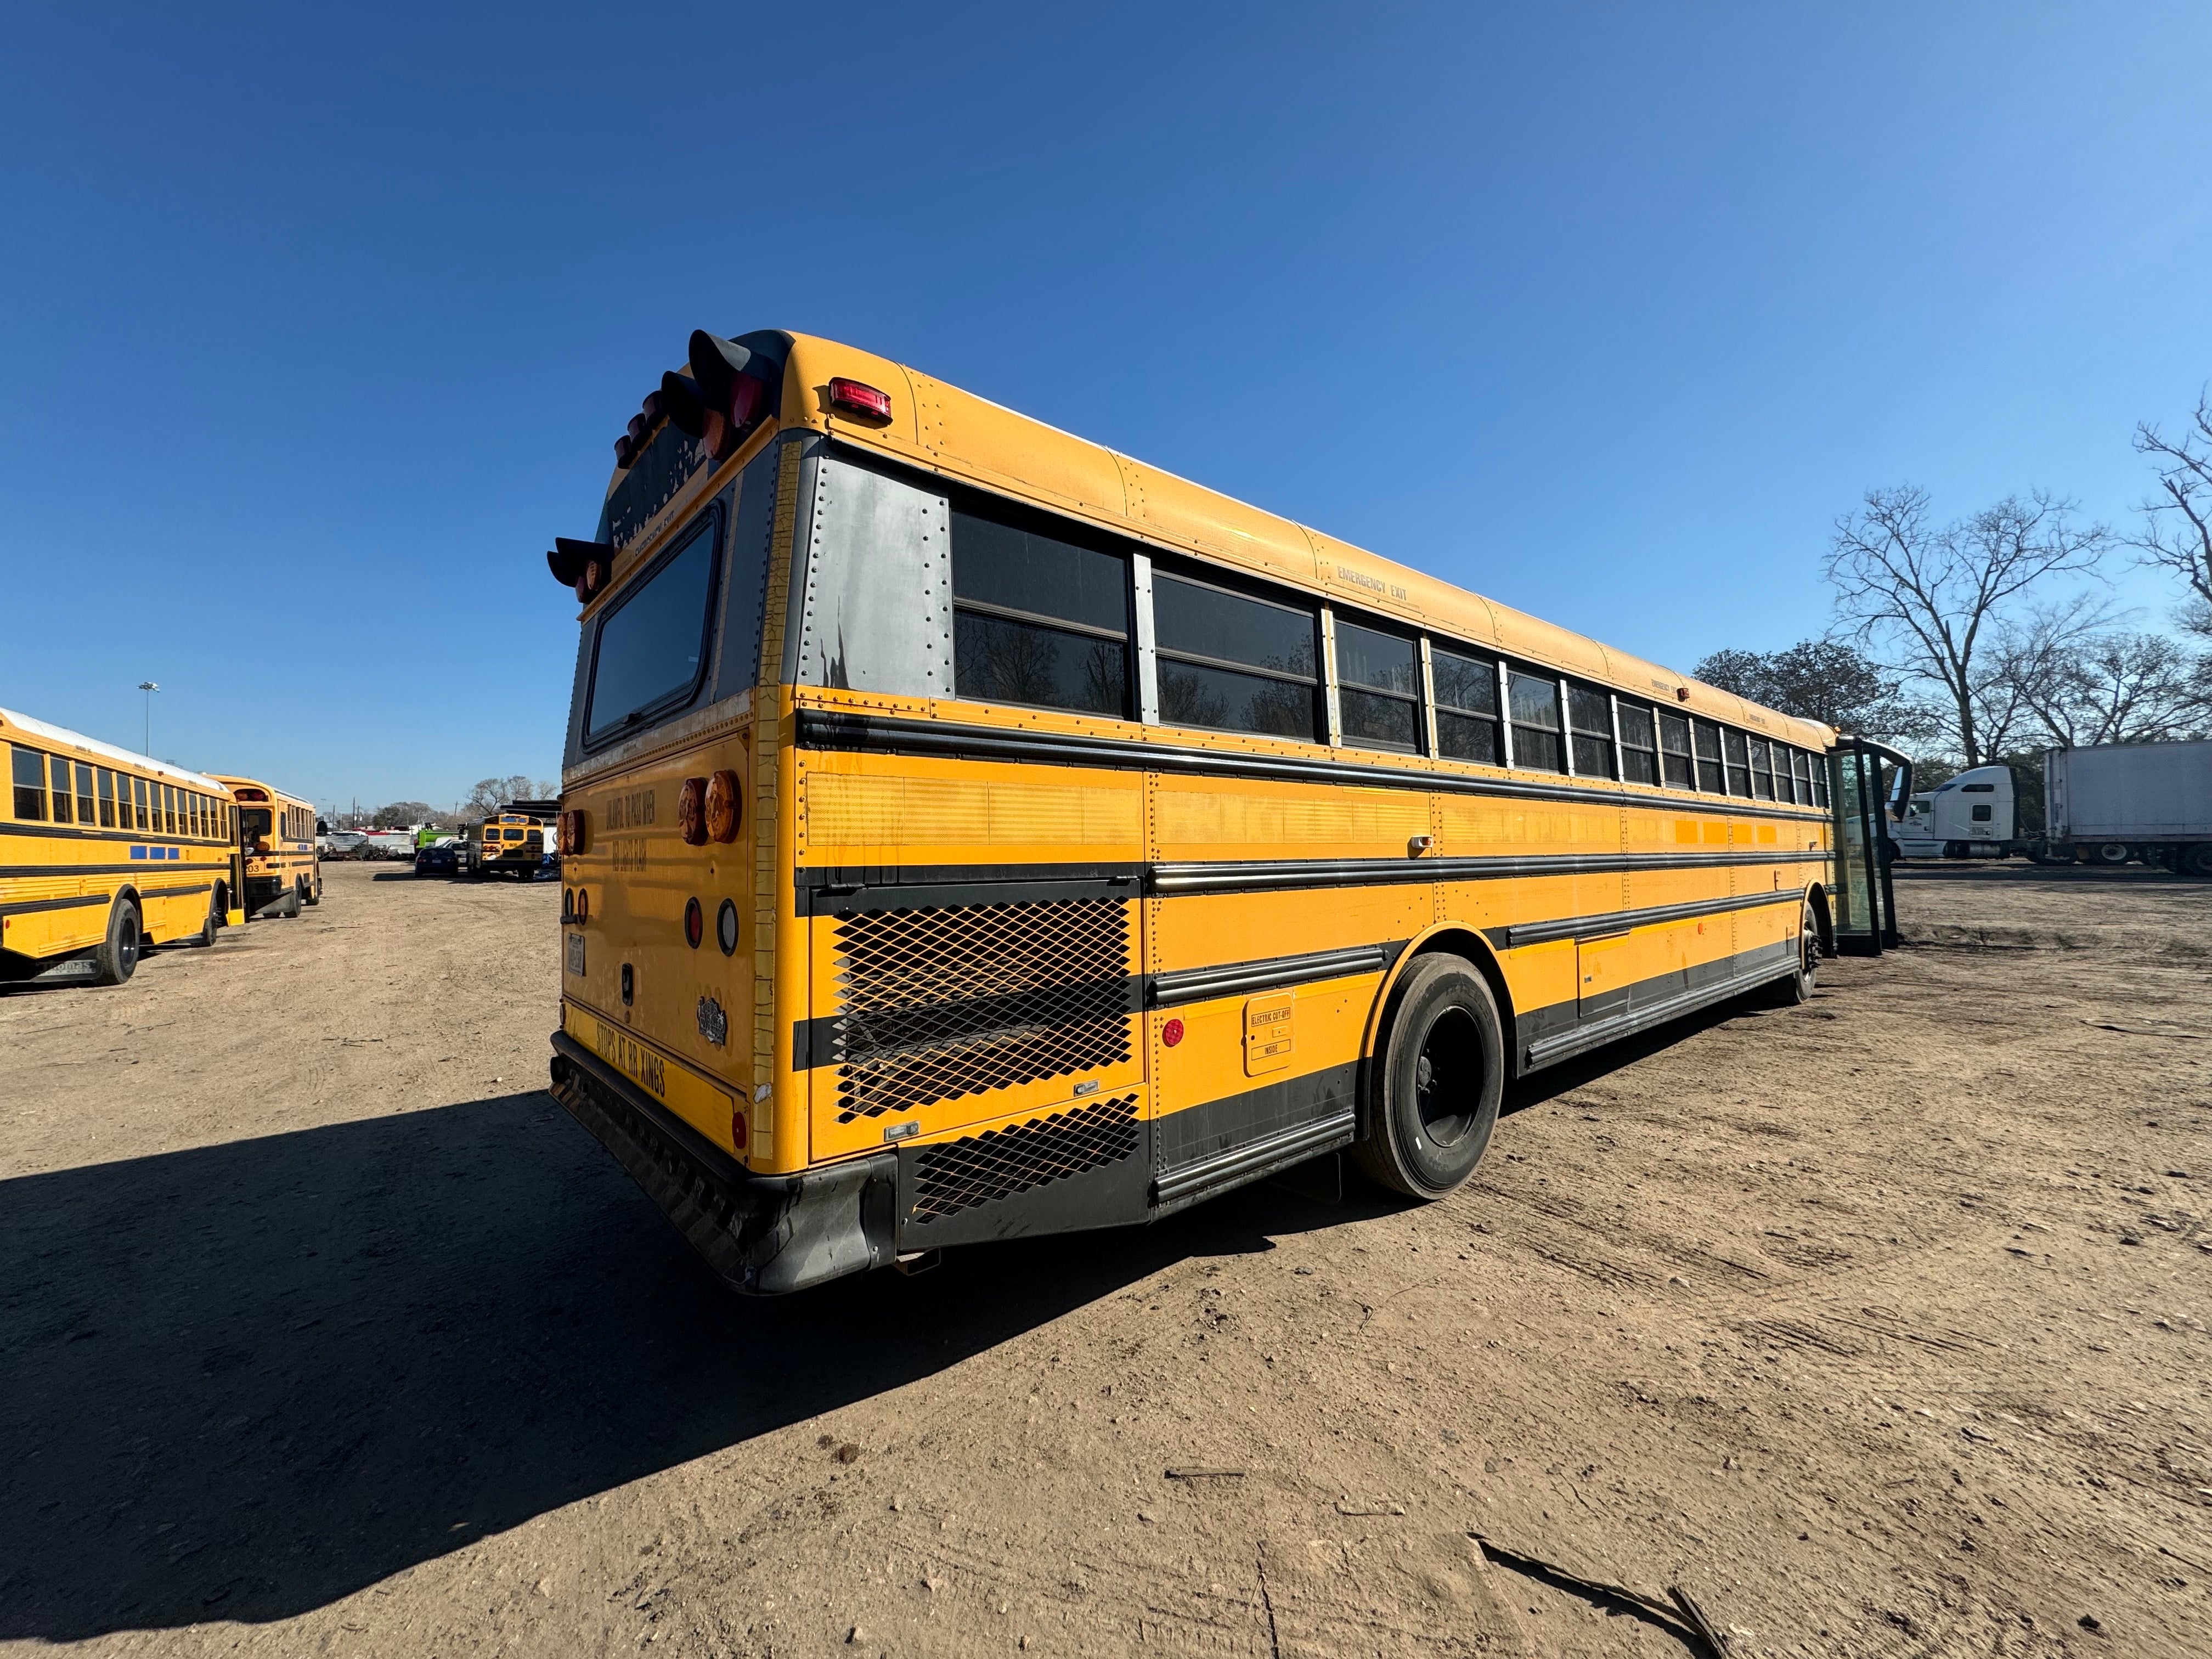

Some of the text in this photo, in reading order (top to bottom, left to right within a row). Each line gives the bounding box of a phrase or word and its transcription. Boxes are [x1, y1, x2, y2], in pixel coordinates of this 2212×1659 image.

[1337, 566, 1407, 601] EMERGENCY EXIT
[1252, 1009, 1289, 1025] ELECTRIC CUT-OFF
[597, 1022, 665, 1098] STOPS AT RR XINGS
[1265, 1044, 1278, 1055] INSIDE
